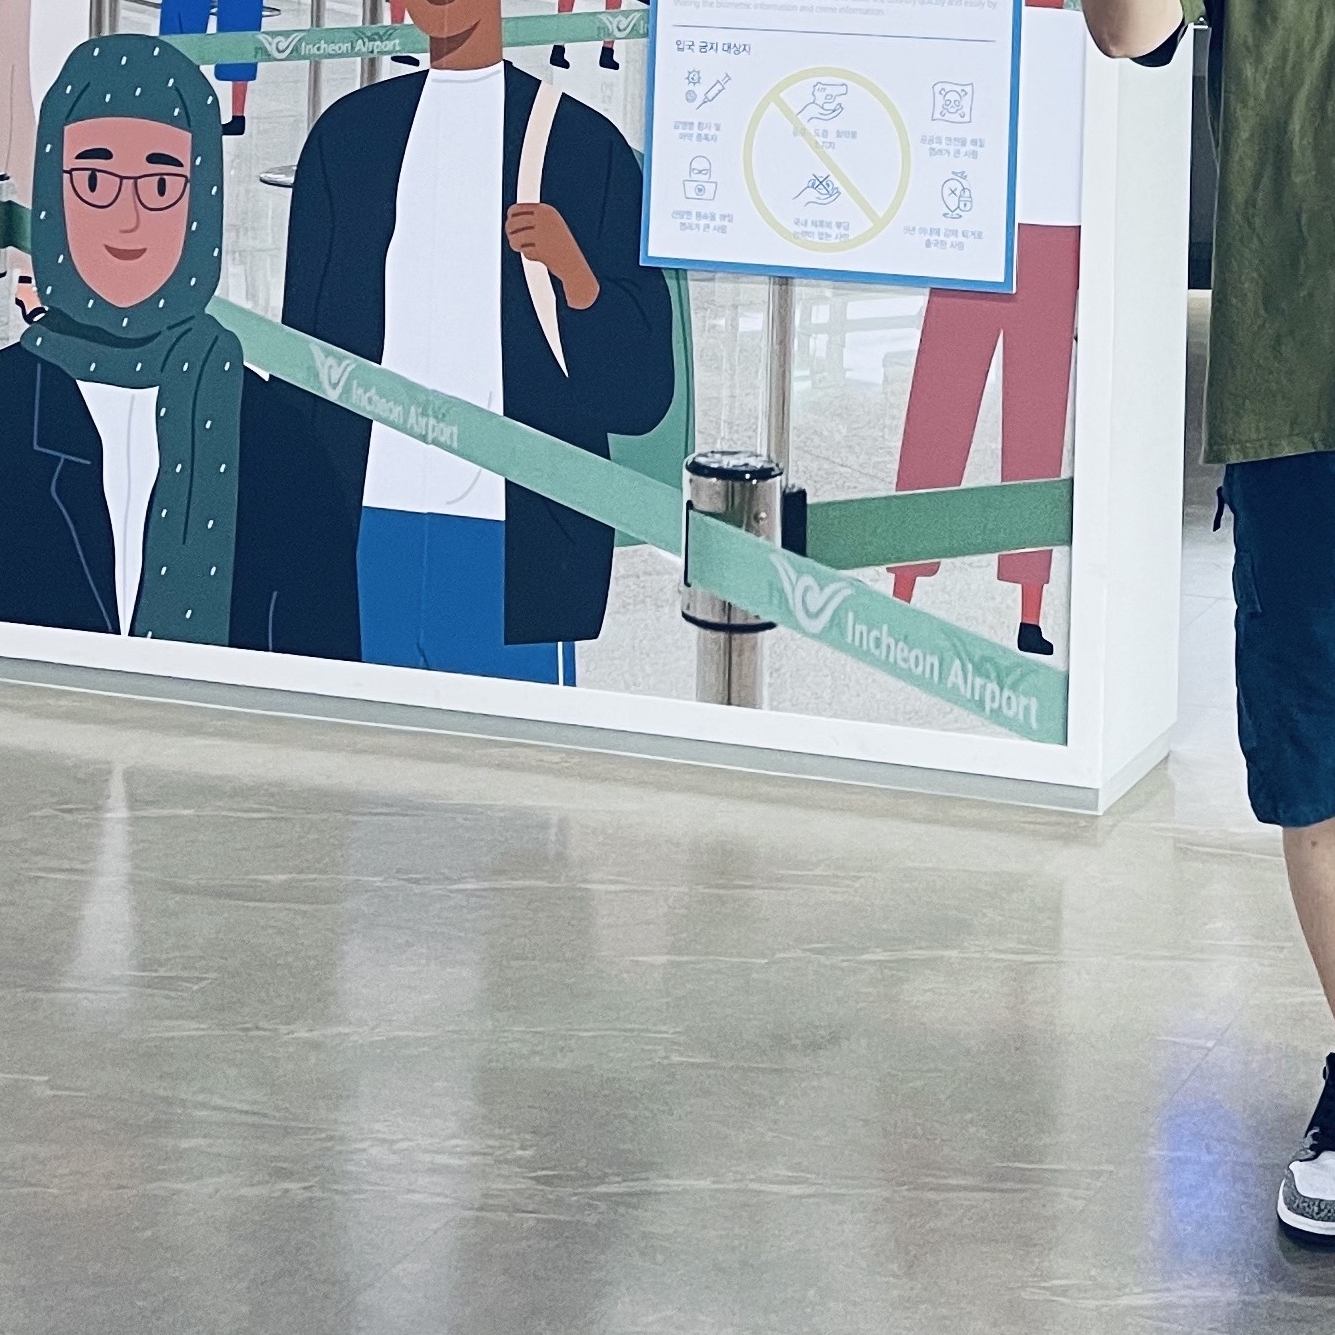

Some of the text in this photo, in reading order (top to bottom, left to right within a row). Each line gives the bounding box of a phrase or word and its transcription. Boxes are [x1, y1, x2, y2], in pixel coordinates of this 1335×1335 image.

[301, 38, 400, 56] Incheon Airport
[675, 39, 751, 55] 입국 금지 대상자
[846, 611, 1039, 730] Incheon Airport
